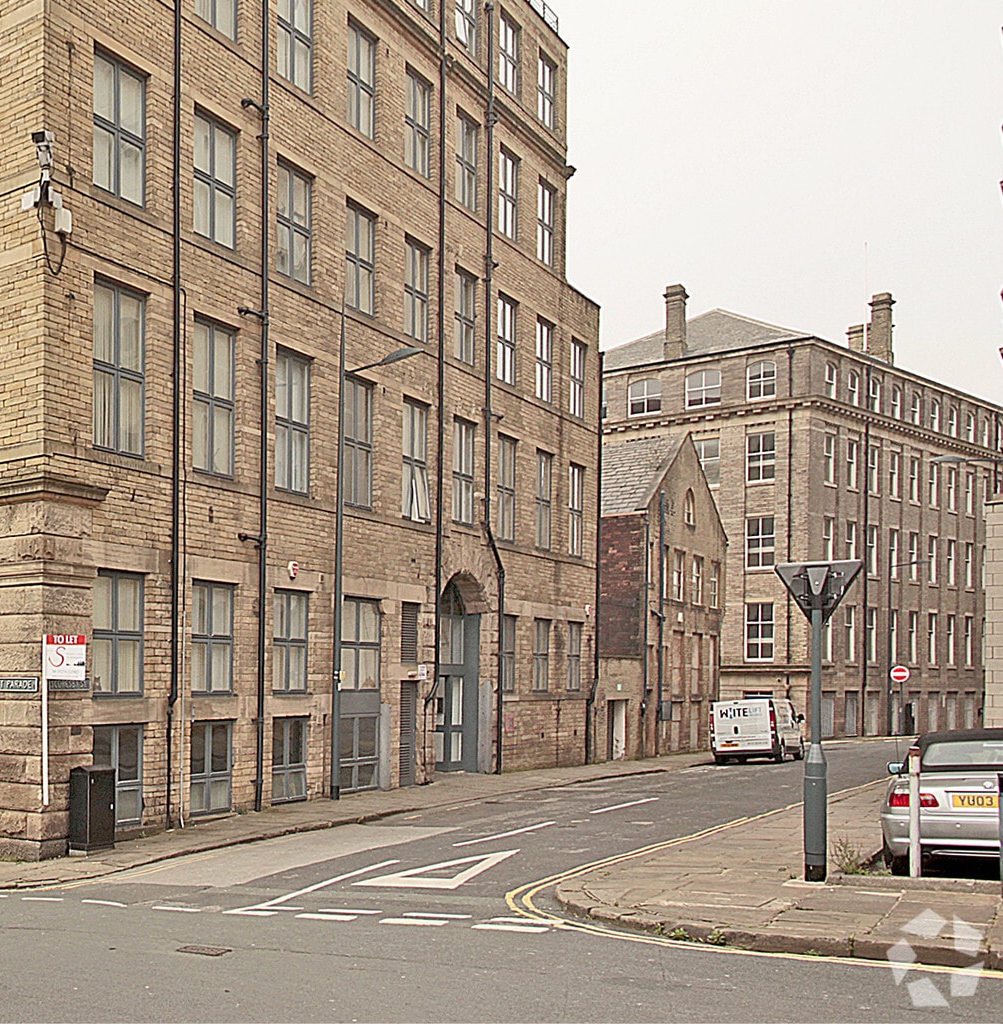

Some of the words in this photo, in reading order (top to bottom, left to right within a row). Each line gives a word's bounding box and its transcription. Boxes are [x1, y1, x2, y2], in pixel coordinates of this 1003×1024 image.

[53, 635, 64, 644] TO
[65, 635, 78, 644] LET
[6, 680, 32, 689] PARADE
[958, 795, 994, 806] YU03
